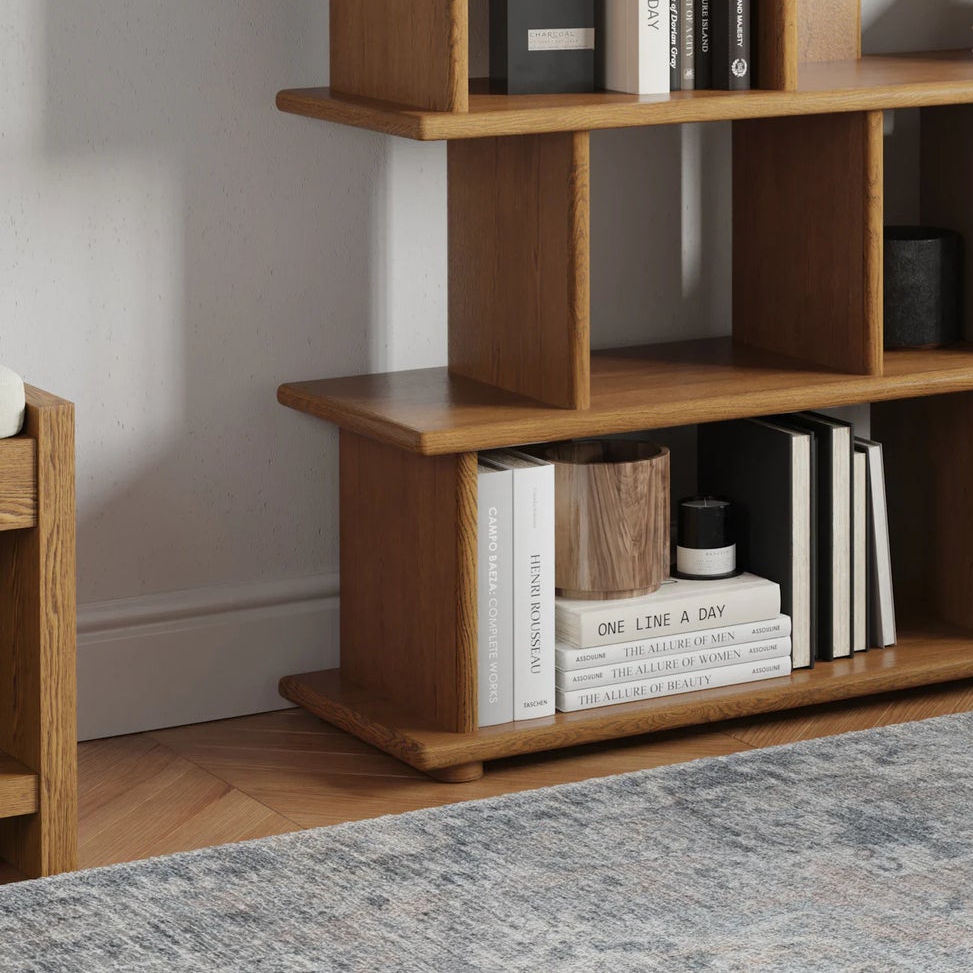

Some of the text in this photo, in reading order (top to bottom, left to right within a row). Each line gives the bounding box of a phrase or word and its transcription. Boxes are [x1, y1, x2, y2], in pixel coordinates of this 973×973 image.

[670, 4, 678, 14] of
[646, 0, 660, 31] DAY
[686, 7, 693, 23] OF
[530, 30, 575, 38] CHARCOAL
[686, 25, 693, 33] A
[488, 507, 498, 704] CAMPO BAEZA: COMPLETE WORKS
[530, 554, 541, 674] HENRI ROUSSEAU
[598, 605, 726, 636] ONE LINE A DAY
[752, 624, 781, 635] ASSOULINE
[624, 632, 736, 658] THE ALLURE OF MEN
[748, 644, 778, 654] ASSOULINE
[576, 652, 606, 662] ASSOULINE
[611, 650, 741, 680] THE ALLURE OF WOMEN
[752, 664, 781, 675] ASSOULINE
[572, 672, 604, 682] ASSOULINE
[579, 675, 712, 706] THE ALLURE OF BEAUTY
[523, 699, 548, 709] TASCHEN
